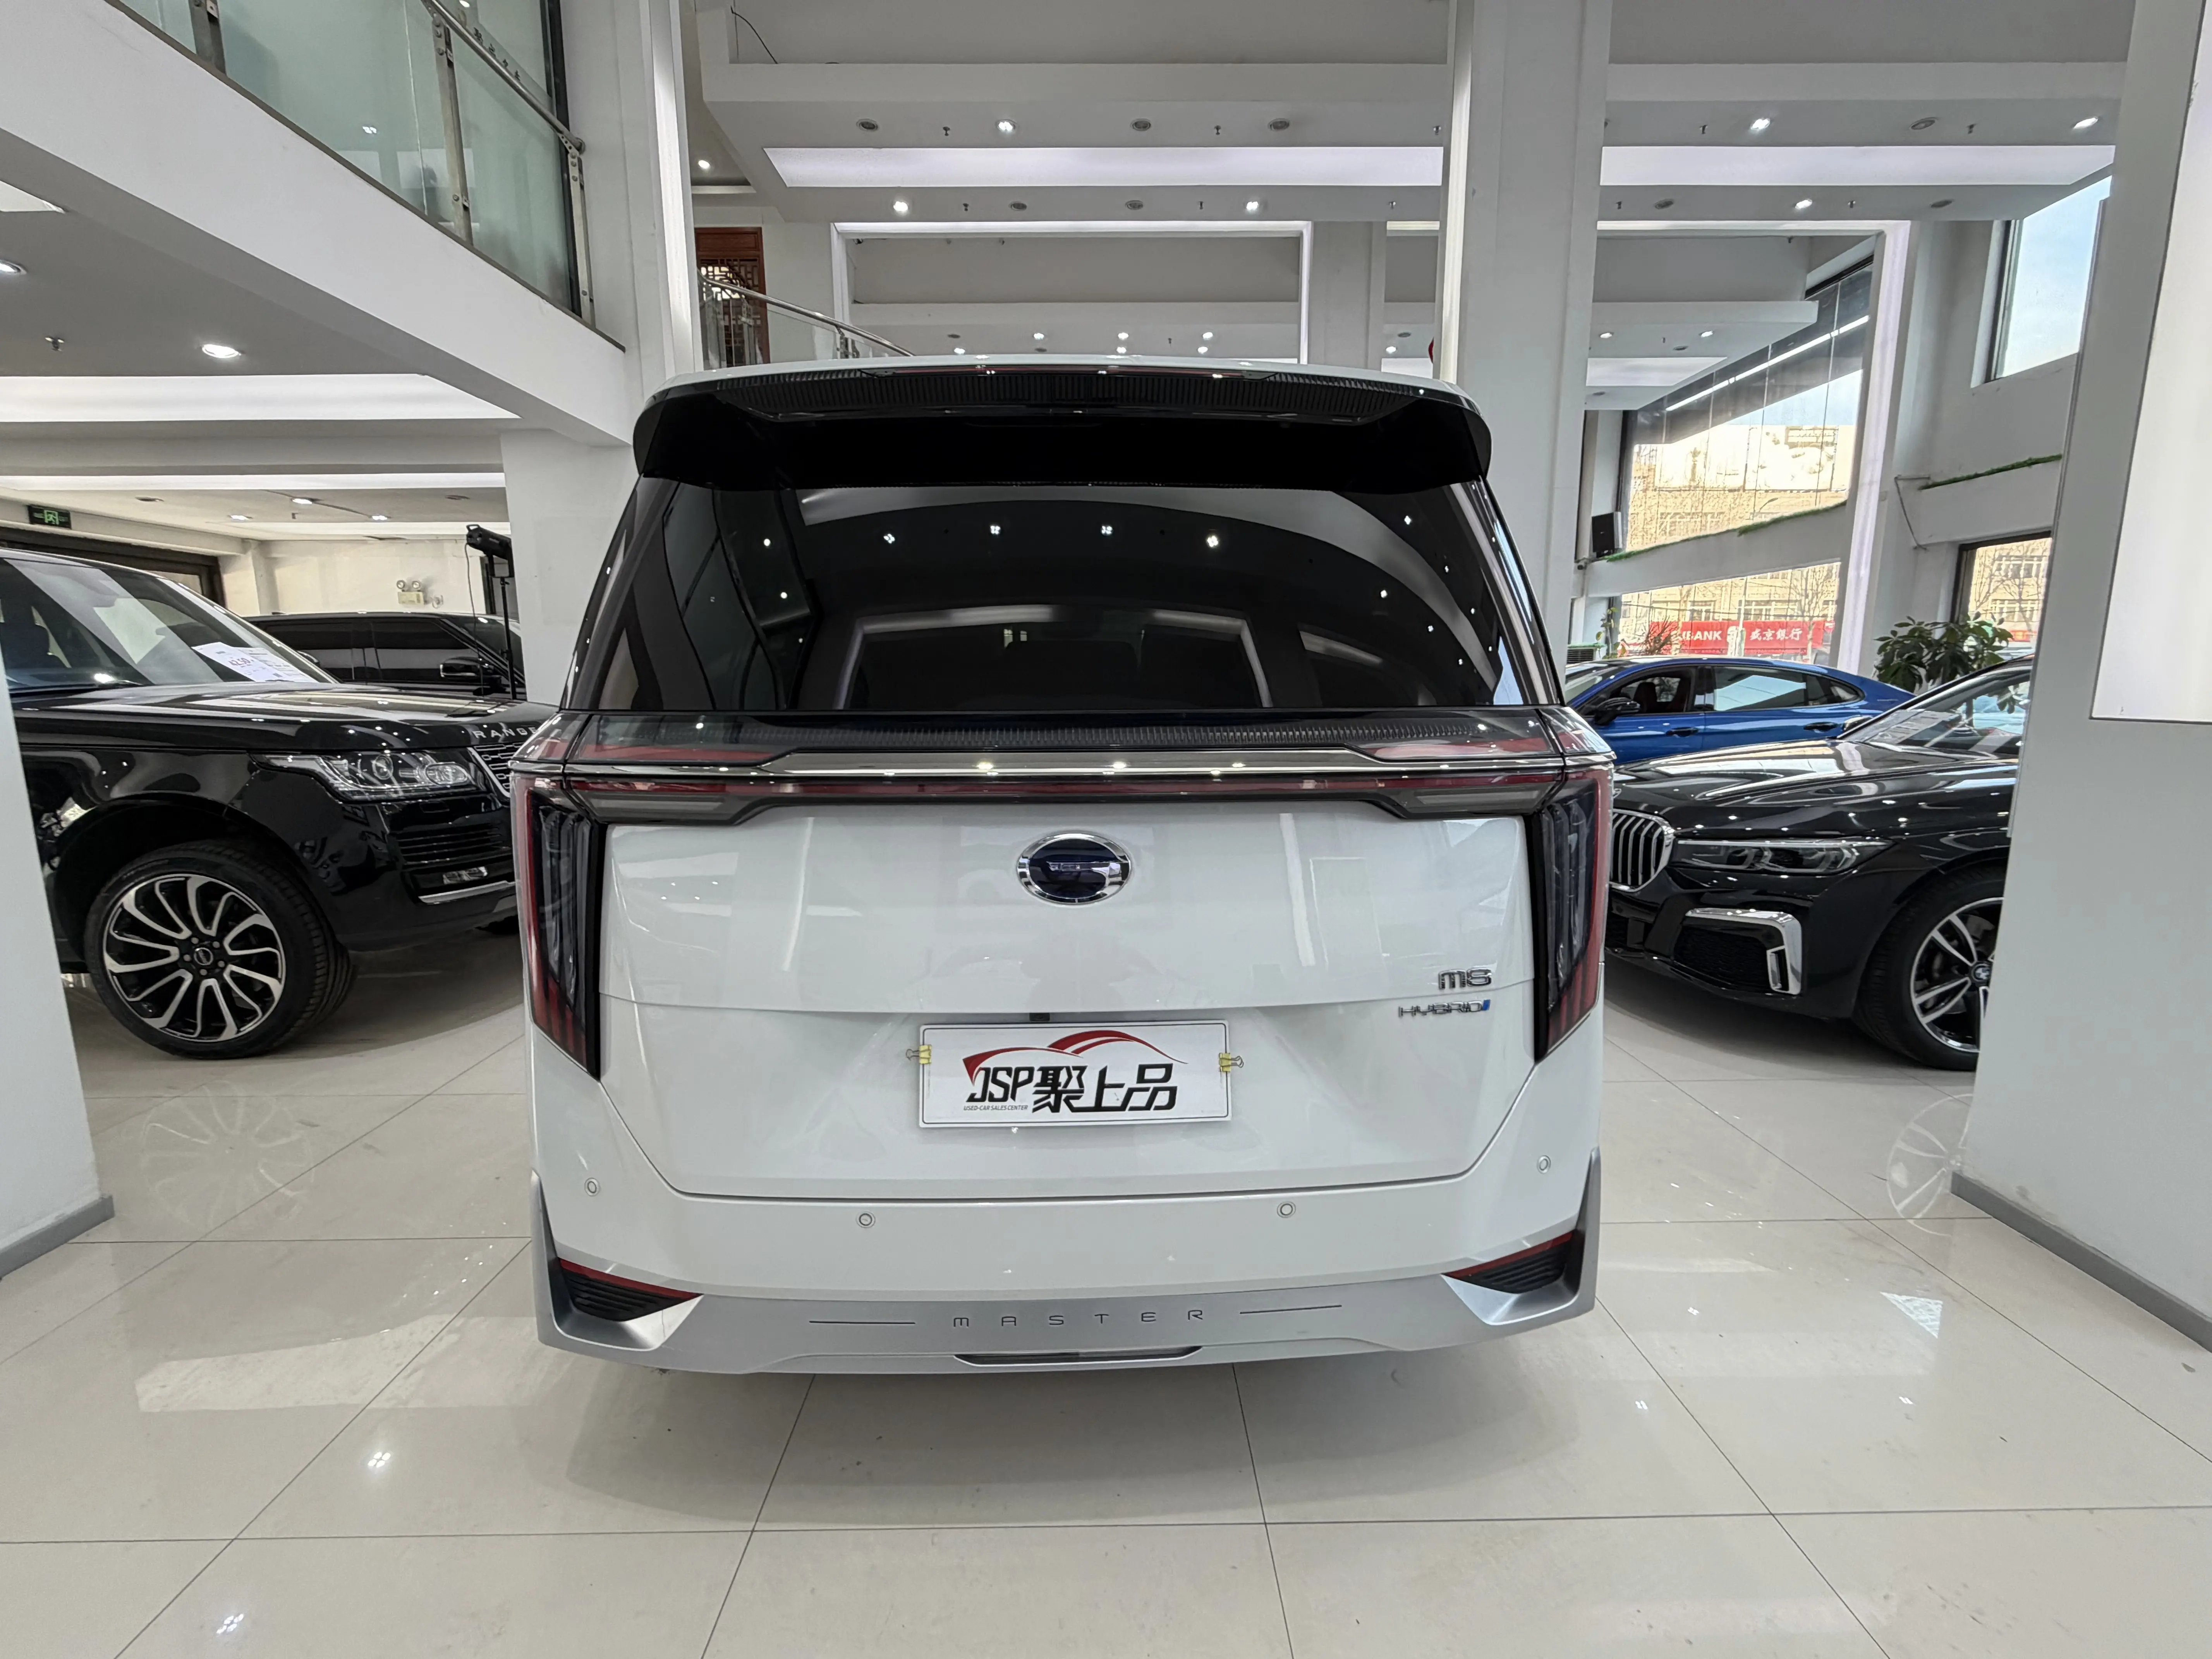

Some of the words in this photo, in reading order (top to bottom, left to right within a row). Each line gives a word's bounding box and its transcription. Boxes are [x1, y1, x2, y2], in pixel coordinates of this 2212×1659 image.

[472, 727, 538, 738] RANGE
[1398, 1000, 1483, 1018] HYBRID
[965, 1066, 1035, 1103] JSP
[1032, 1063, 1178, 1113] 聚上品
[953, 1309, 1203, 1328] MASTER
